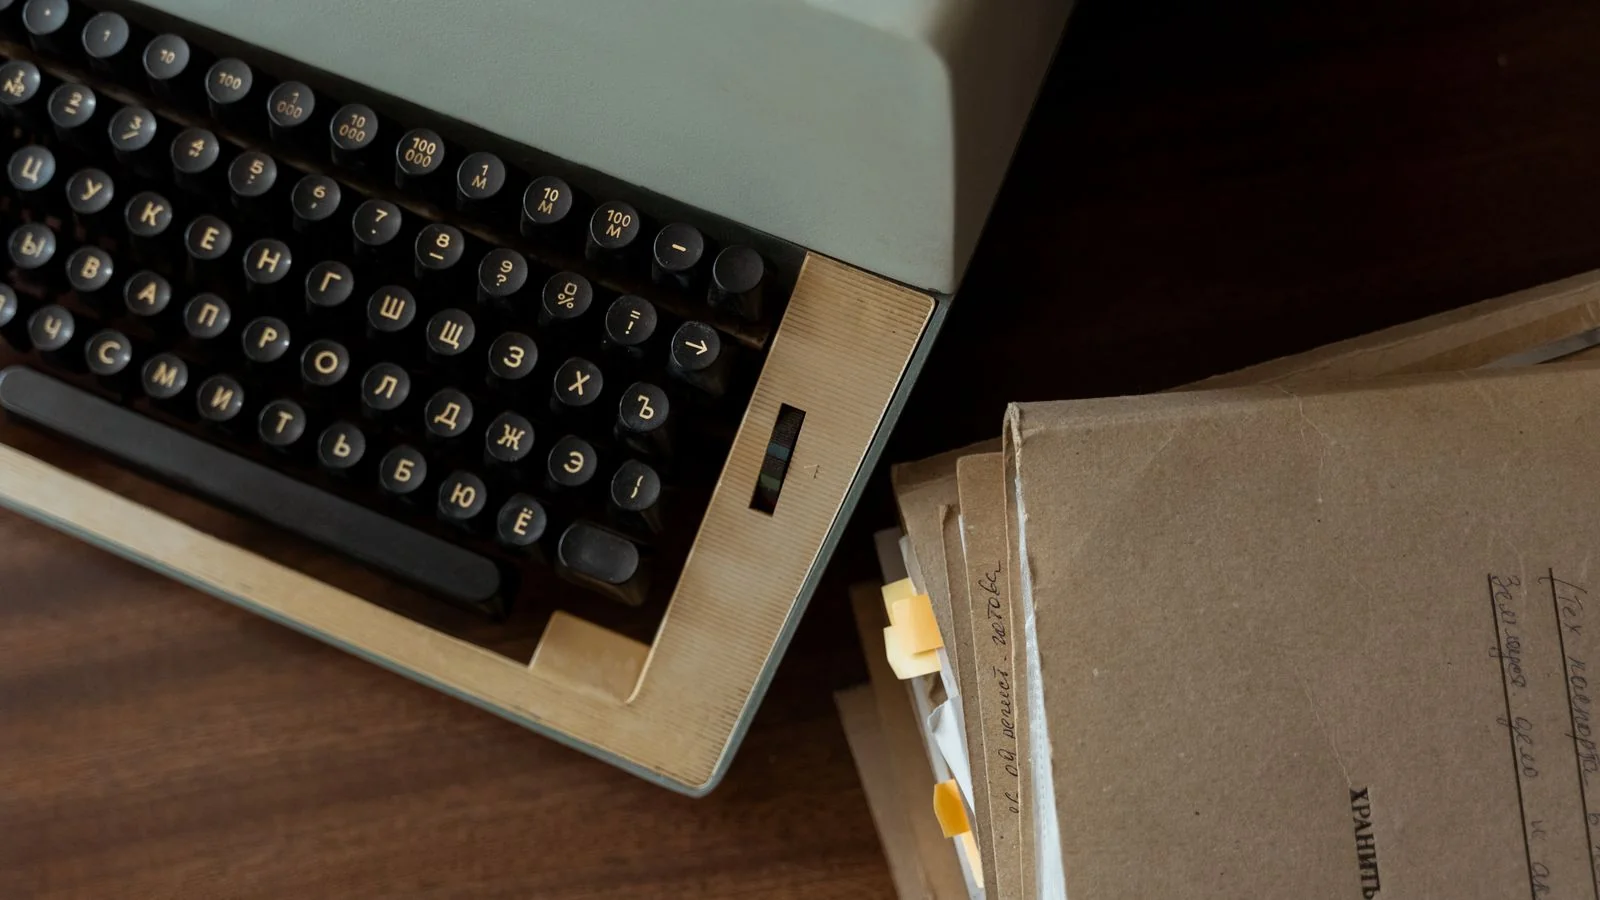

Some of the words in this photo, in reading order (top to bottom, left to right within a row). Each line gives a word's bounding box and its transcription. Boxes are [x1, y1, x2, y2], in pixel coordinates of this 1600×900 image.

[160, 50, 175, 64] 10
[219, 72, 242, 90] 100
[69, 92, 83, 107] 2
[277, 102, 303, 119] 000
[129, 115, 142, 130] 3
[351, 114, 365, 128] 10
[339, 124, 365, 142] 000
[192, 138, 205, 152] 4
[413, 138, 436, 155] 100
[250, 160, 264, 175] 5
[405, 149, 432, 167] 000
[21, 156, 43, 184] Ц
[80, 178, 103, 200] У
[313, 185, 326, 199] 6
[544, 188, 559, 201] 10
[141, 201, 164, 226] К
[375, 209, 388, 222] 7
[608, 210, 630, 228] 100
[21, 232, 45, 257] Ы
[200, 226, 220, 250] Е
[436, 233, 450, 248] 8
[80, 256, 100, 279] В
[257, 248, 281, 273] Н
[500, 260, 512, 273] 9
[320, 272, 342, 292] Г
[496, 274, 507, 286] ?
[138, 282, 157, 305] А
[558, 293, 574, 308] %
[198, 303, 220, 327] П
[380, 295, 405, 321] Ш
[44, 315, 62, 340] Ч
[258, 327, 278, 348] Р
[439, 320, 463, 350] Щ
[100, 340, 121, 364] С
[314, 351, 338, 374] О
[152, 362, 178, 387] М
[568, 370, 590, 396] Х
[210, 386, 233, 411] И
[374, 375, 398, 399] Л
[434, 402, 460, 430] Д
[638, 395, 654, 420] Ъ
[276, 410, 293, 434] Т
[333, 433, 351, 457] Ь
[498, 424, 525, 450] Ж
[393, 459, 414, 482] Б
[564, 452, 584, 474] Э
[450, 482, 476, 508] Ю
[514, 508, 533, 536] Ё
[1349, 786, 1380, 900] ХРАНИТЬ
